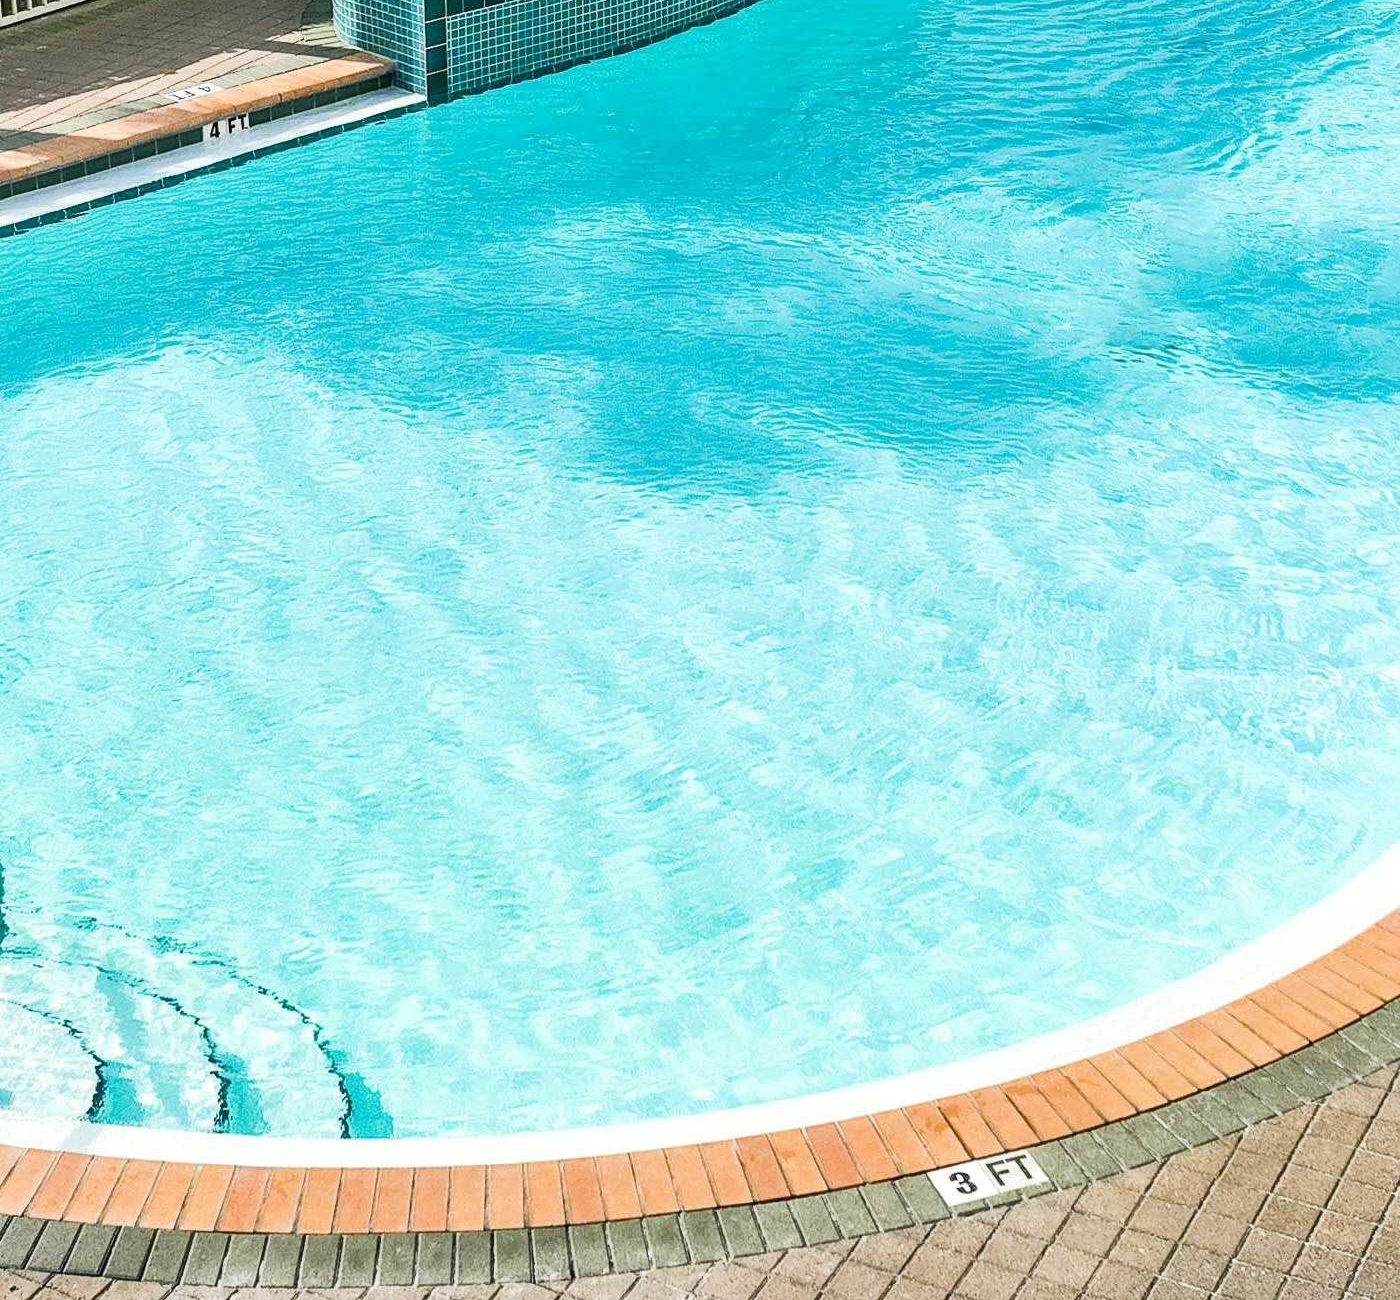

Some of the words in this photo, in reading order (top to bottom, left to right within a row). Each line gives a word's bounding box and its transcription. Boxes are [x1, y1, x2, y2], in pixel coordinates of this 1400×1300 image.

[210, 121, 220, 138] 4
[949, 1172, 978, 1194] 3
[986, 1155, 1032, 1186] FT
